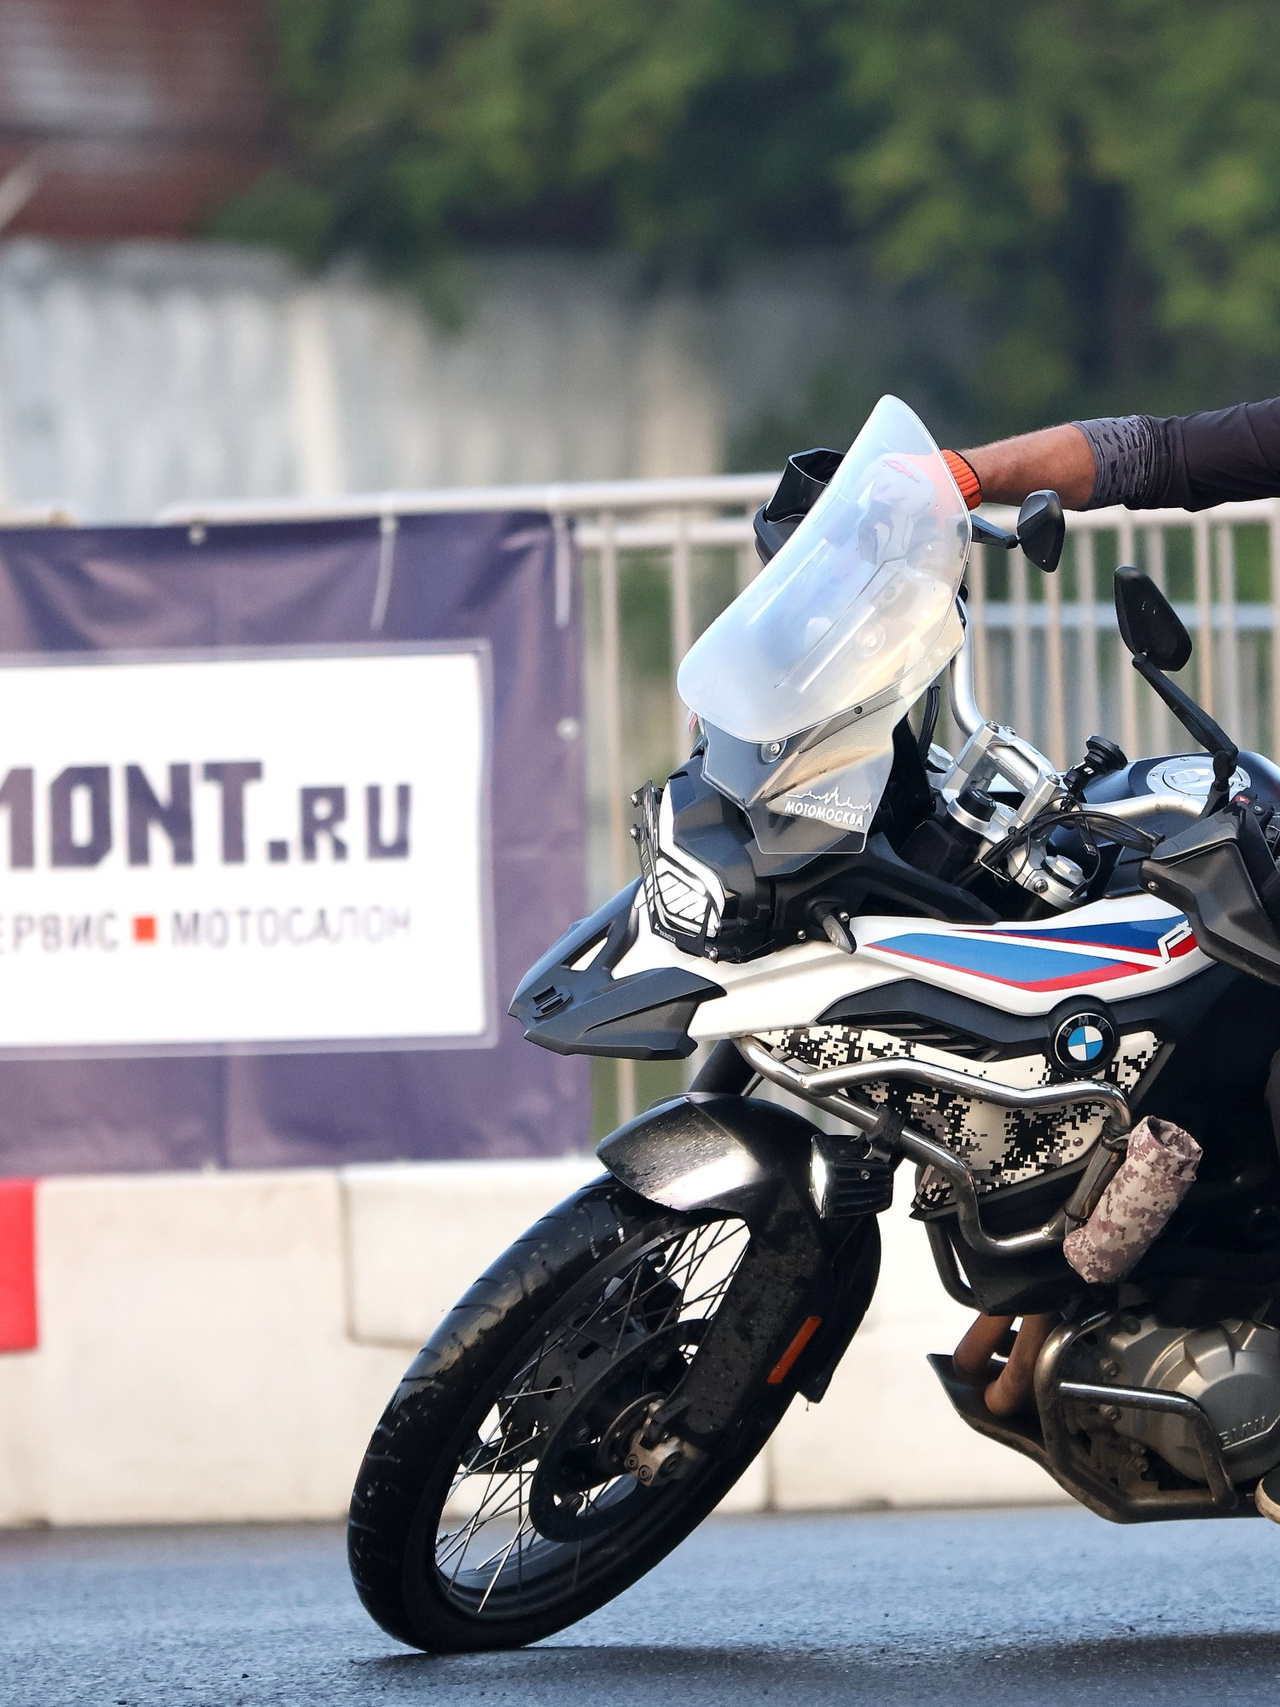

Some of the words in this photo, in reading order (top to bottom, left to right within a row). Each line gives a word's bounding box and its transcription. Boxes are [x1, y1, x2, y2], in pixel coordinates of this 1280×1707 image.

[786, 801, 864, 827] МОТОМОСКВА
[0, 907, 119, 953] РВИС
[171, 906, 412, 949] МОТОСАЛОН
[1061, 1015, 1108, 1038] BMW
